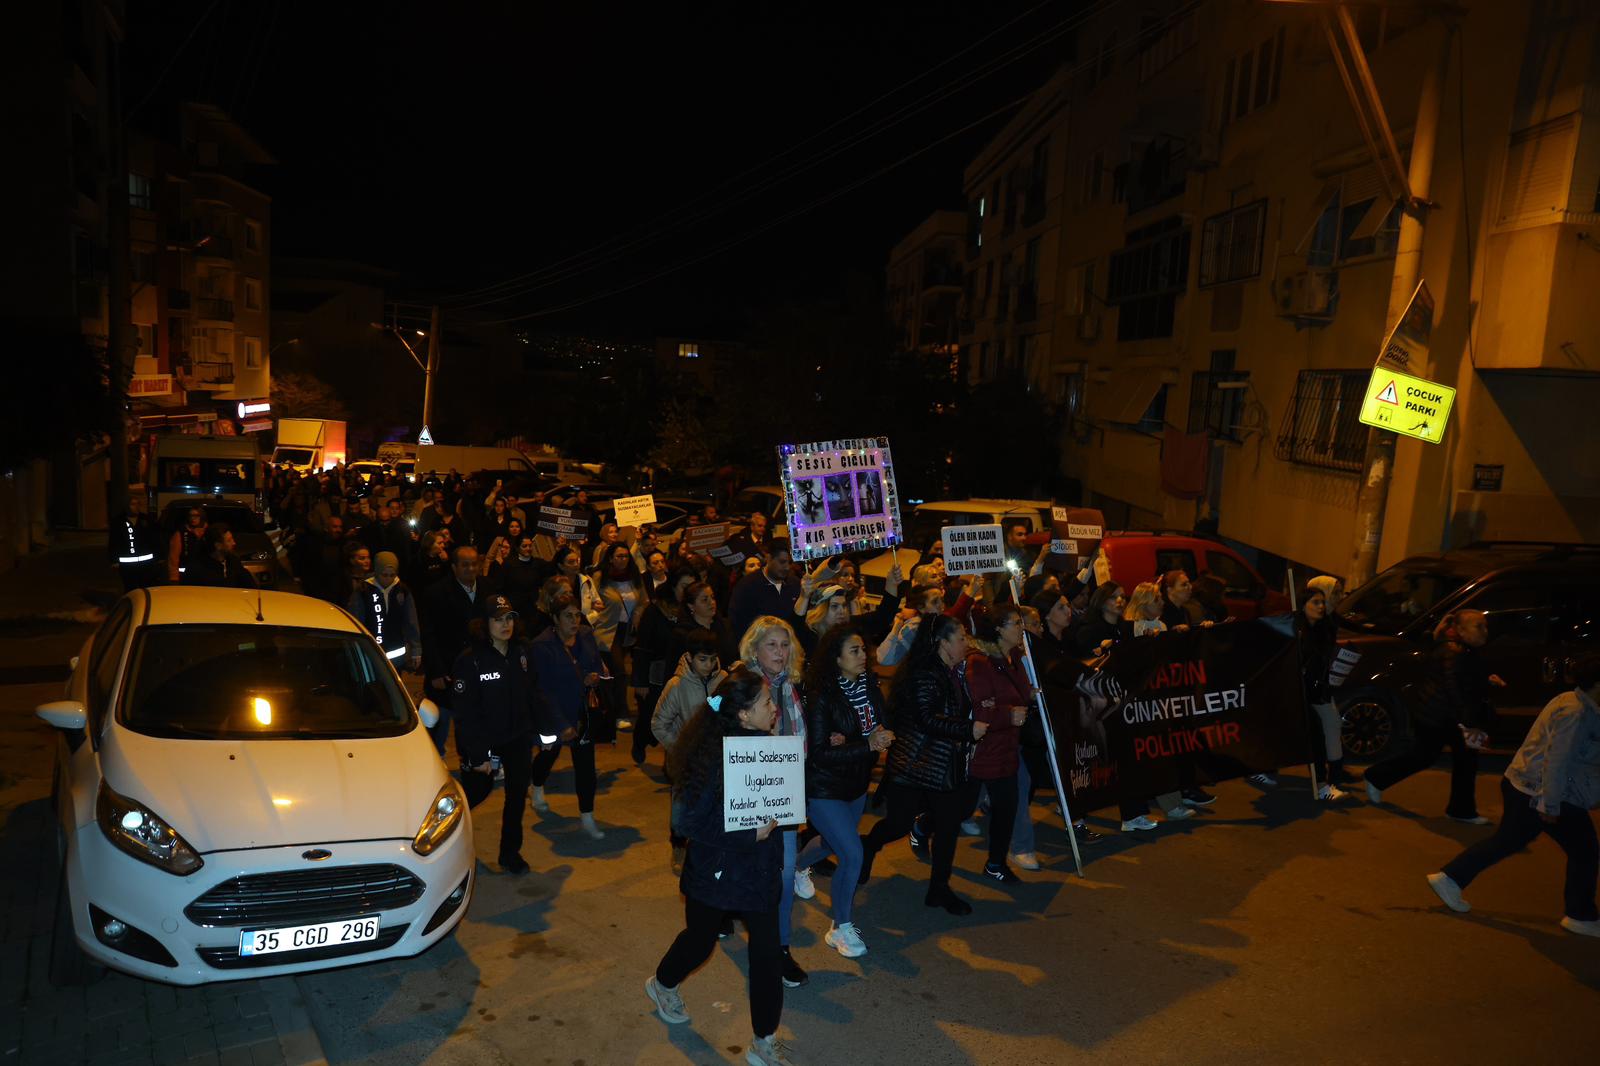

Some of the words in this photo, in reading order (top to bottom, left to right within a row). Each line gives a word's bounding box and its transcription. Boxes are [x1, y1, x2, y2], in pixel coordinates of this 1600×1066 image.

[1406, 387, 1443, 404] ÇOCUK
[1405, 402, 1436, 417] PARKI
[805, 529, 825, 544] KIR
[949, 530, 965, 542] ÖLEN
[966, 529, 977, 541] BİR
[978, 530, 997, 540] KADIN
[951, 545, 967, 556] ÖLEN
[968, 544, 979, 555] BİR
[979, 543, 998, 555] İNSAN
[947, 559, 964, 571] ÖLEN
[965, 558, 976, 570] BİR
[1144, 659, 1208, 689] ADIN
[1122, 683, 1247, 725] CİNAYETLERİ
[1134, 720, 1242, 762] POLİTİKTİR
[255, 932, 280, 951] 35
[293, 926, 329, 947] CGD
[340, 921, 375, 942] 296
